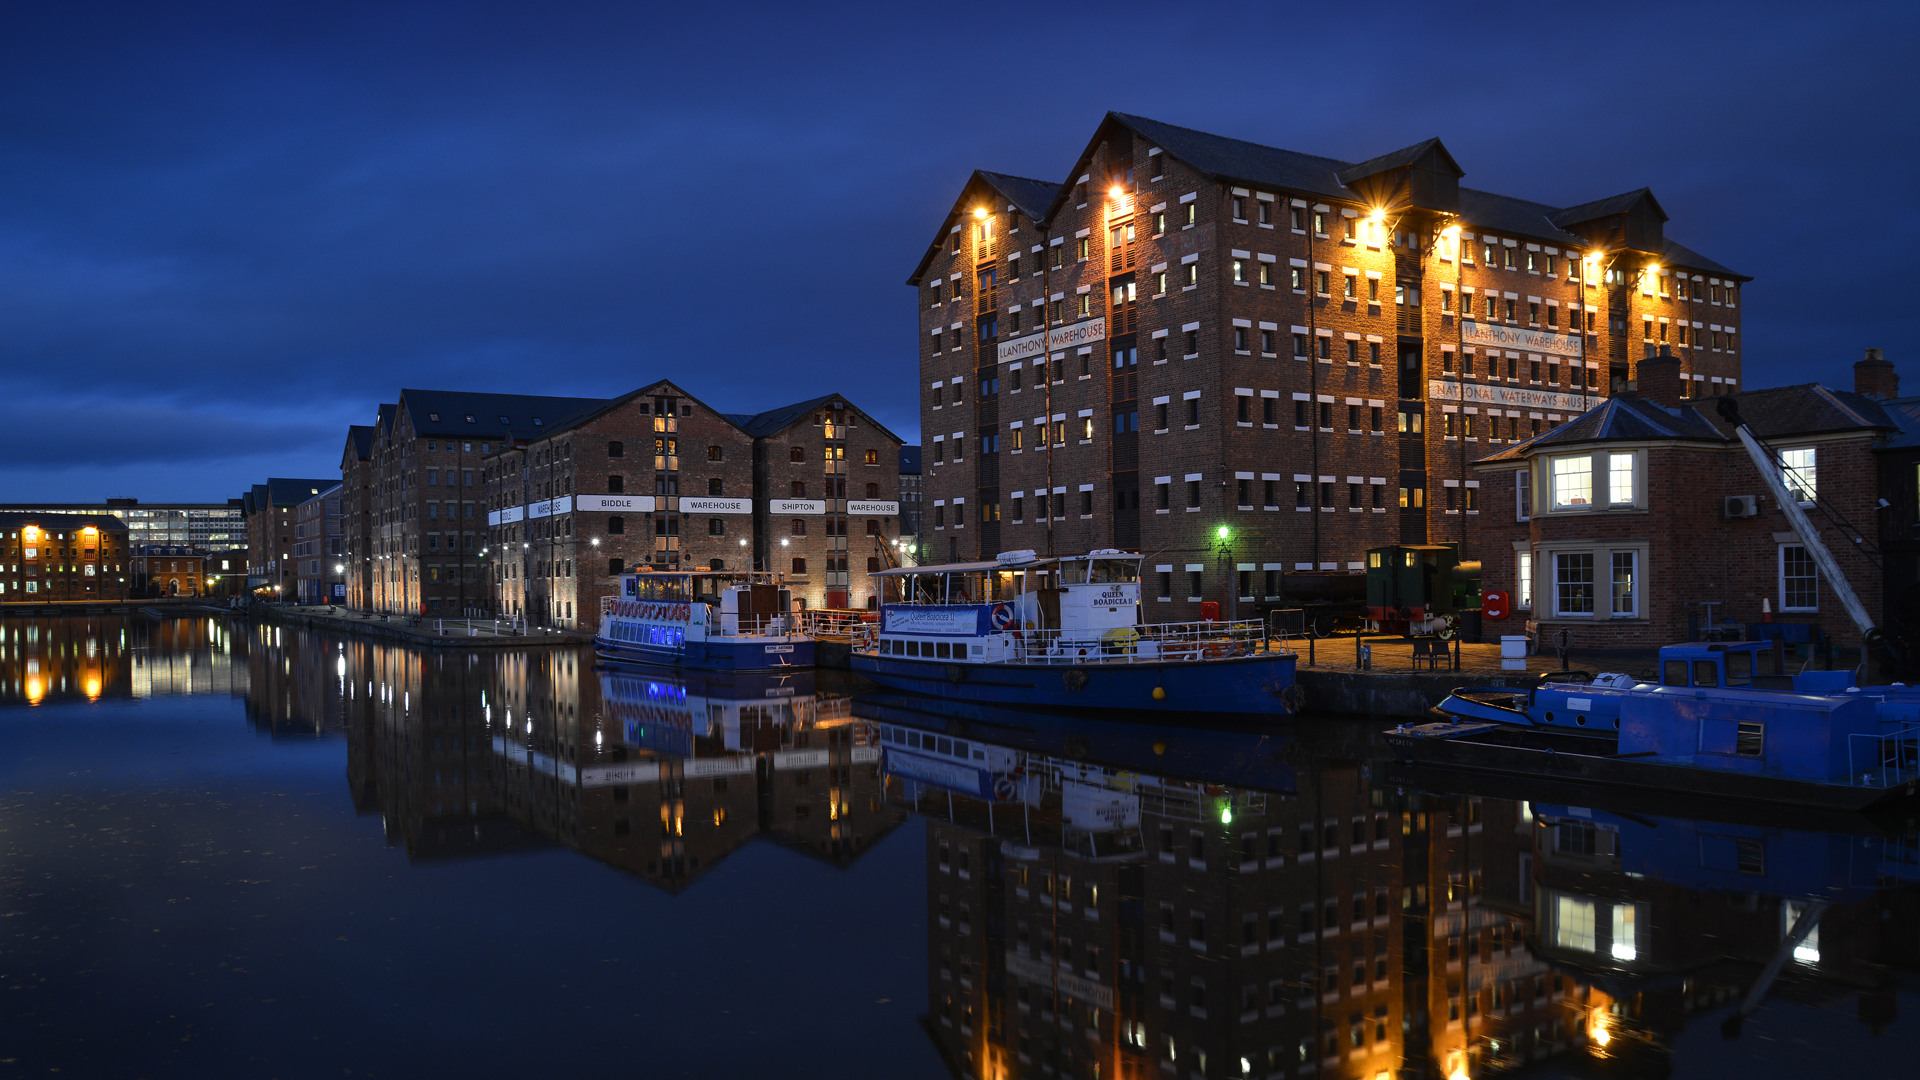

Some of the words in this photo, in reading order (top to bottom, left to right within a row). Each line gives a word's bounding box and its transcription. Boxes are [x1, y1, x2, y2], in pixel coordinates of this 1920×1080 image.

[1000, 337, 1047, 358] LLANTHONY
[1051, 323, 1103, 345] WAREHOUSE
[1465, 326, 1521, 344] LLANTHONY
[1525, 334, 1579, 352] WAREHOUSE
[1437, 384, 1494, 401] NATONAL
[1500, 391, 1558, 406] WATERWAYS
[601, 499, 632, 508] BIDDLE
[690, 501, 741, 510] WAREHOUSE
[781, 503, 815, 511] SHIPTON
[850, 504, 896, 512] WAREHOUSE
[910, 612, 926, 622] Queen
[926, 612, 949, 621] Boadicea
[950, 612, 955, 621] II
[1388, 738, 1414, 747] HESKETH
